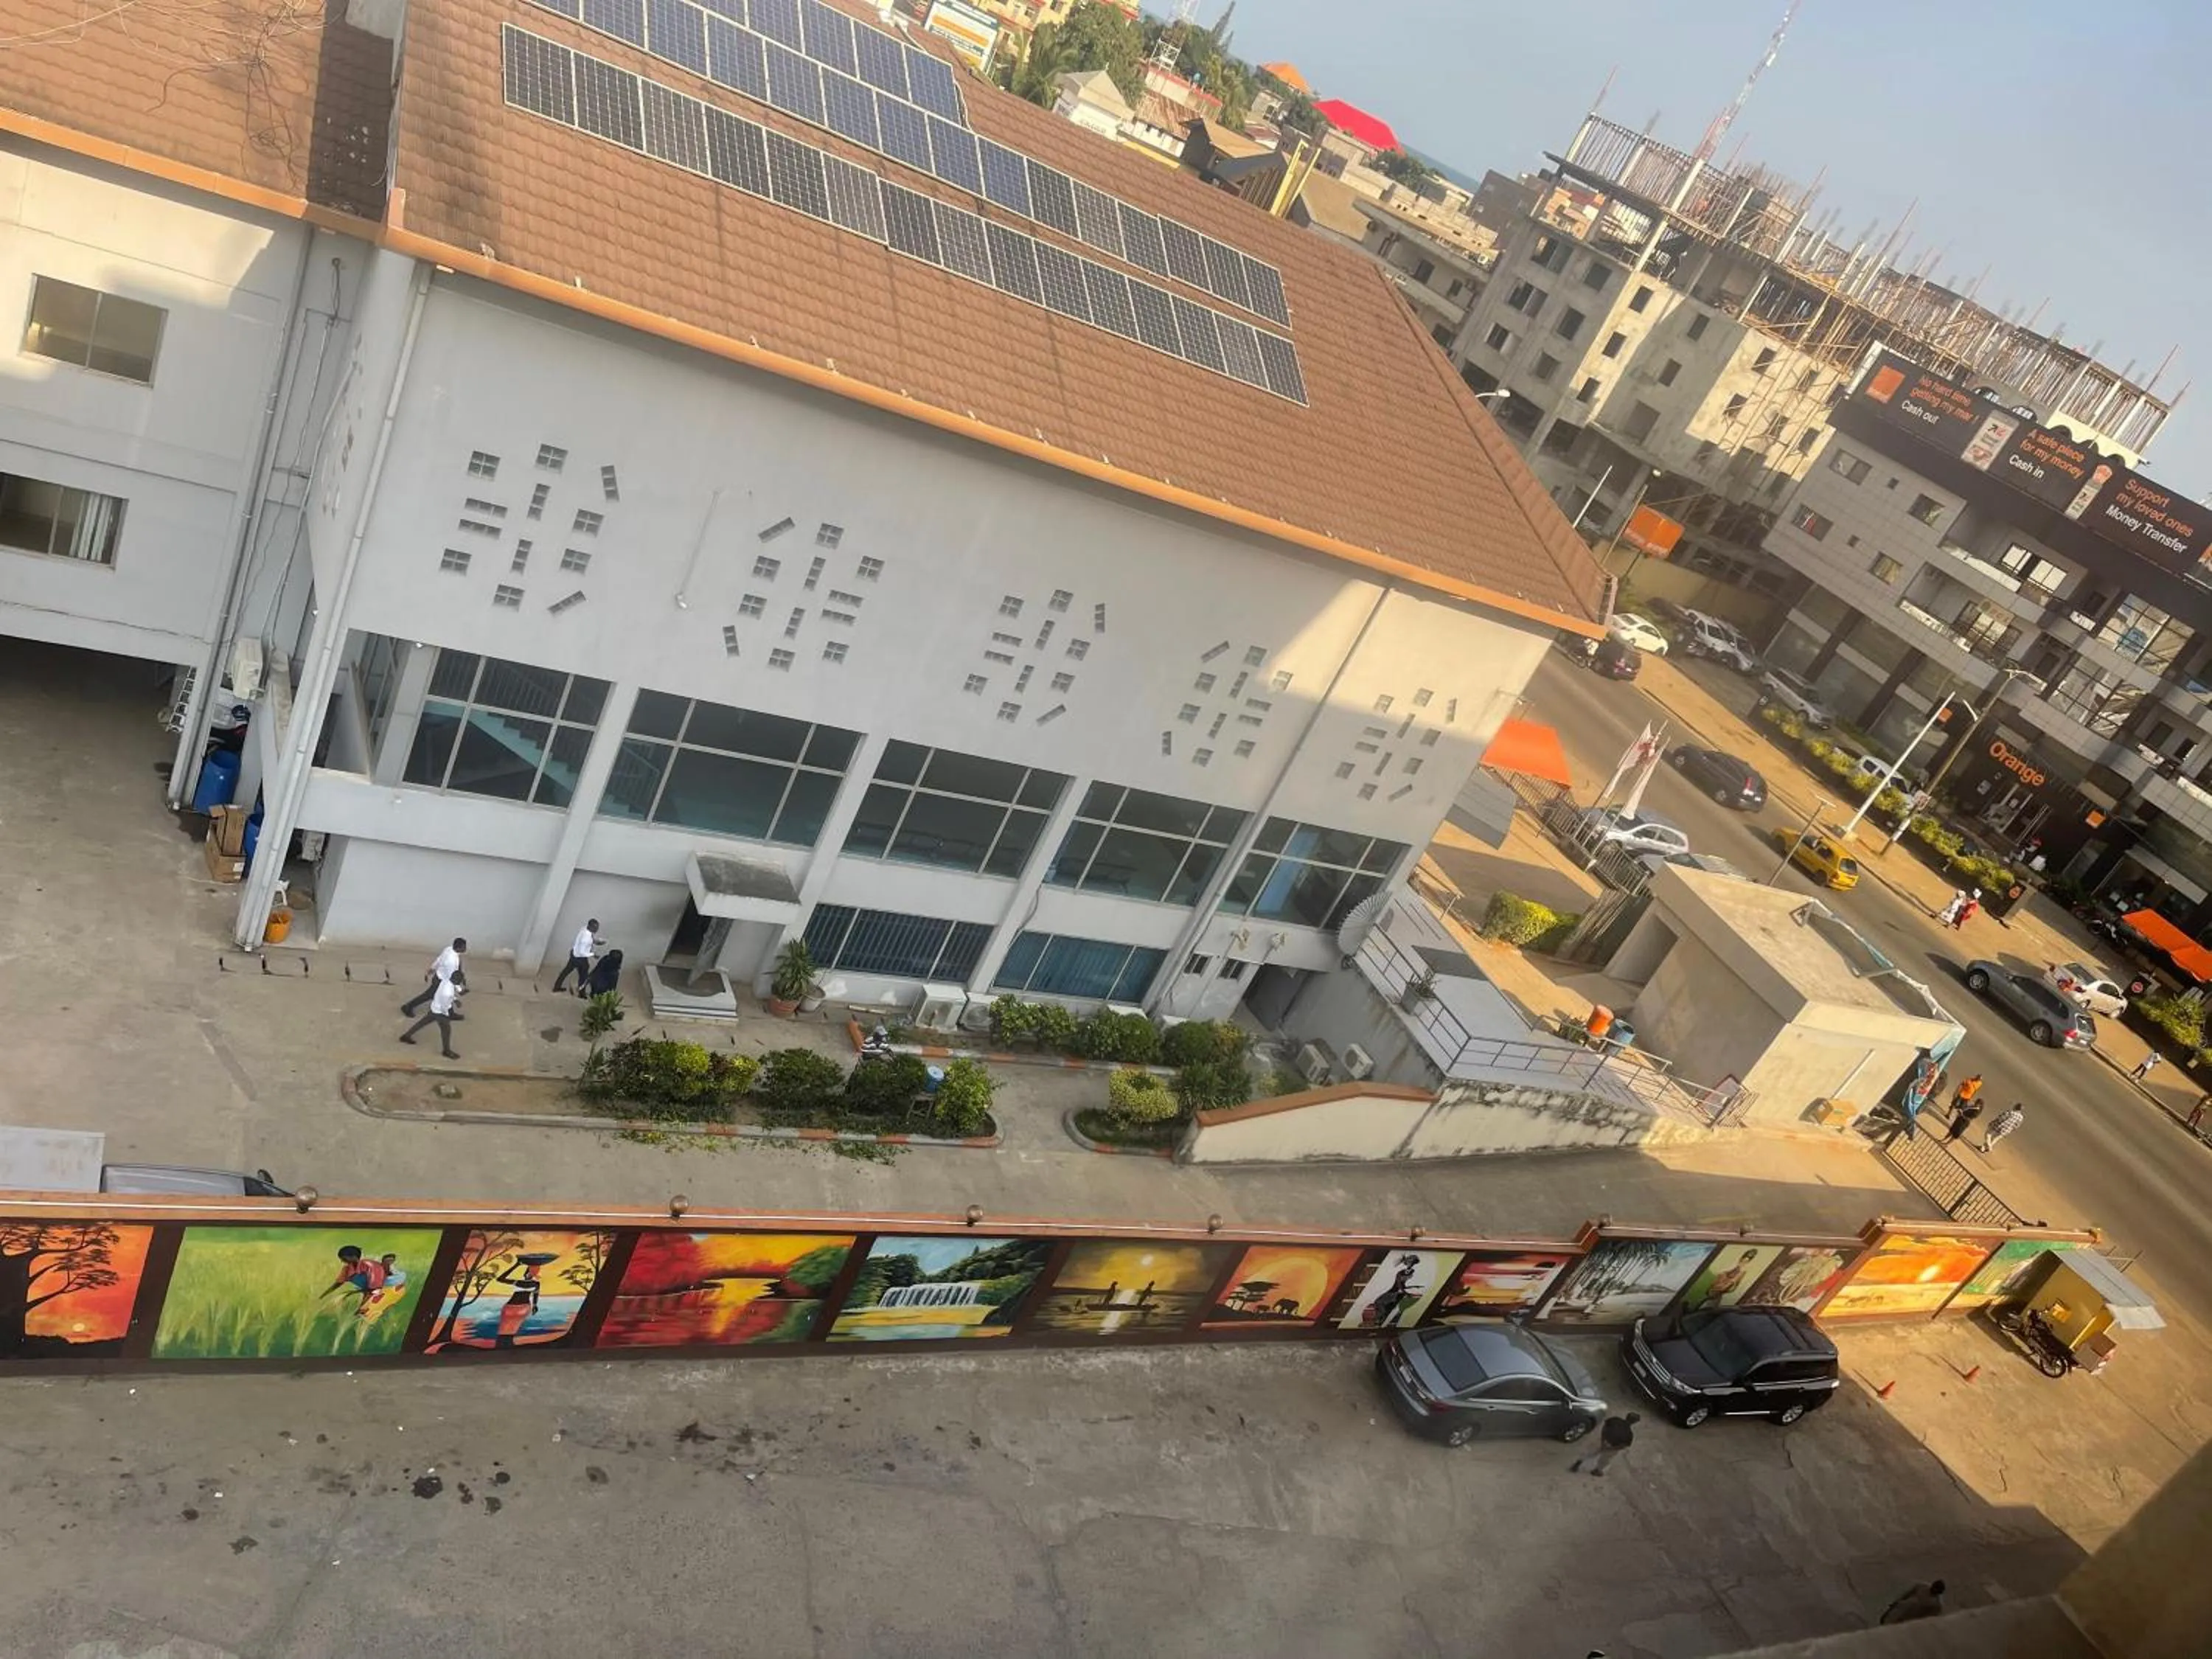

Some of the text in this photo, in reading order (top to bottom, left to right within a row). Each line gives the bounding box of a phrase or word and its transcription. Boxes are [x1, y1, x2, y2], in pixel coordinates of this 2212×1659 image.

[1902, 400, 1940, 425] Cash out
[2028, 428, 2037, 439] A
[2038, 434, 2058, 450] safe
[2009, 453, 2045, 479] Cash in
[2020, 439, 2085, 479] for my money
[2125, 479, 2171, 508] Support
[2105, 504, 2142, 532] Money
[2142, 522, 2188, 552] Transfer
[2116, 492, 2194, 538] my loved ones
[1989, 741, 2045, 786] Orange
